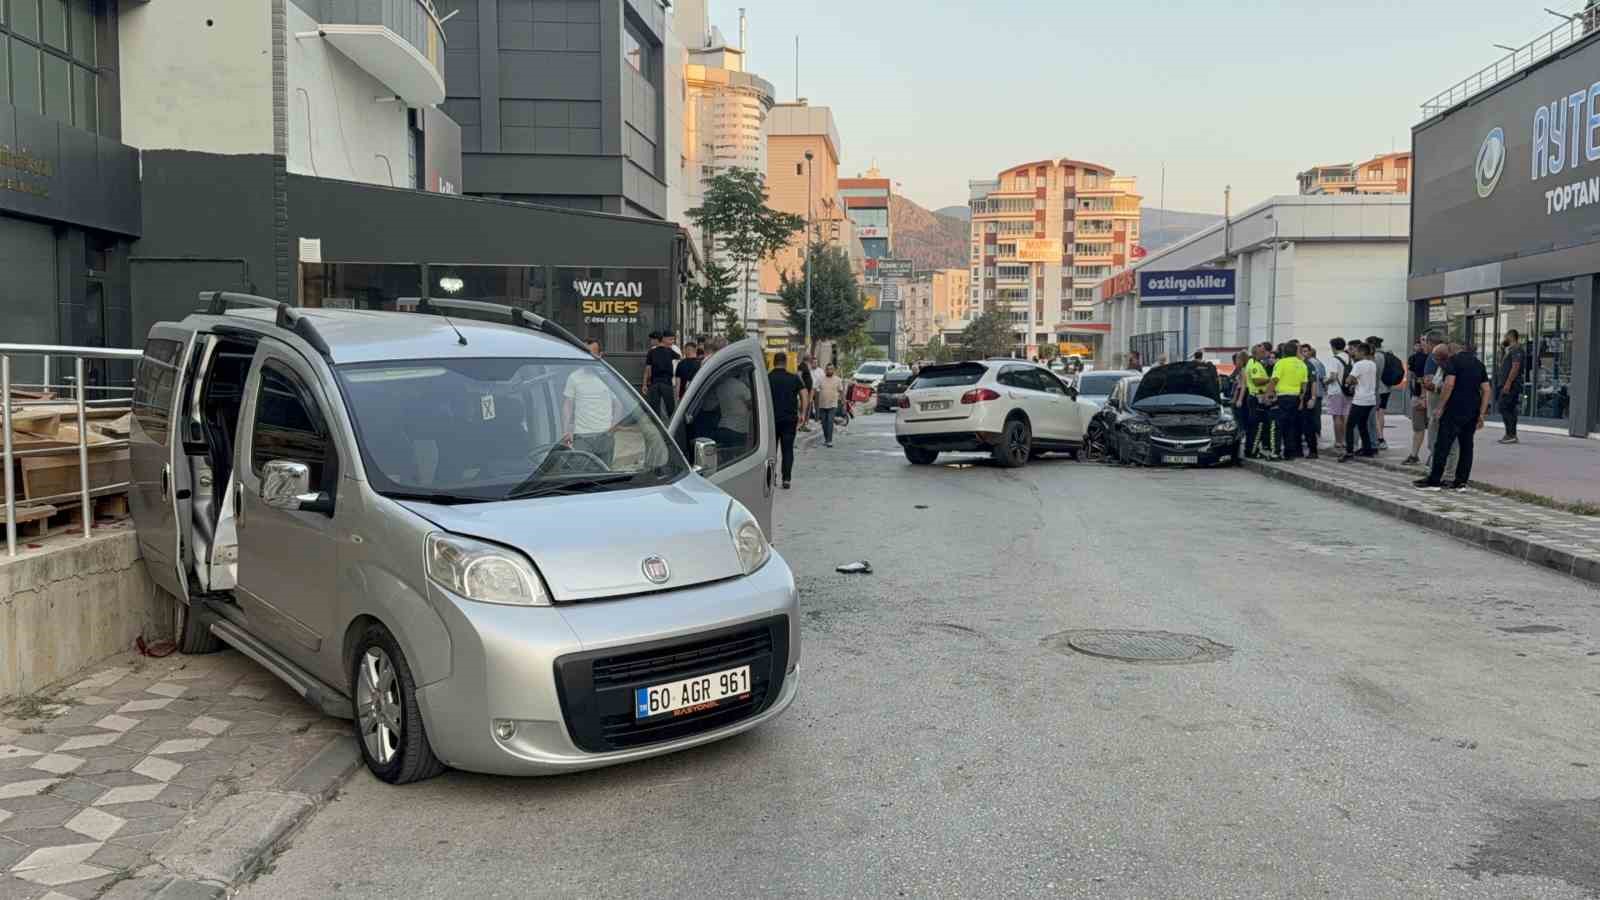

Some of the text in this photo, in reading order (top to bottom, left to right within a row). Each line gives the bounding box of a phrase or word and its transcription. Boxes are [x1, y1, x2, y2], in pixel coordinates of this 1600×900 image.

[1545, 176, 1600, 215] TOPTAN
[578, 281, 642, 297] VATAN
[583, 301, 638, 313] SUITE'S
[649, 688, 670, 711] 60
[681, 679, 710, 705] AGR
[720, 669, 747, 695] 961
